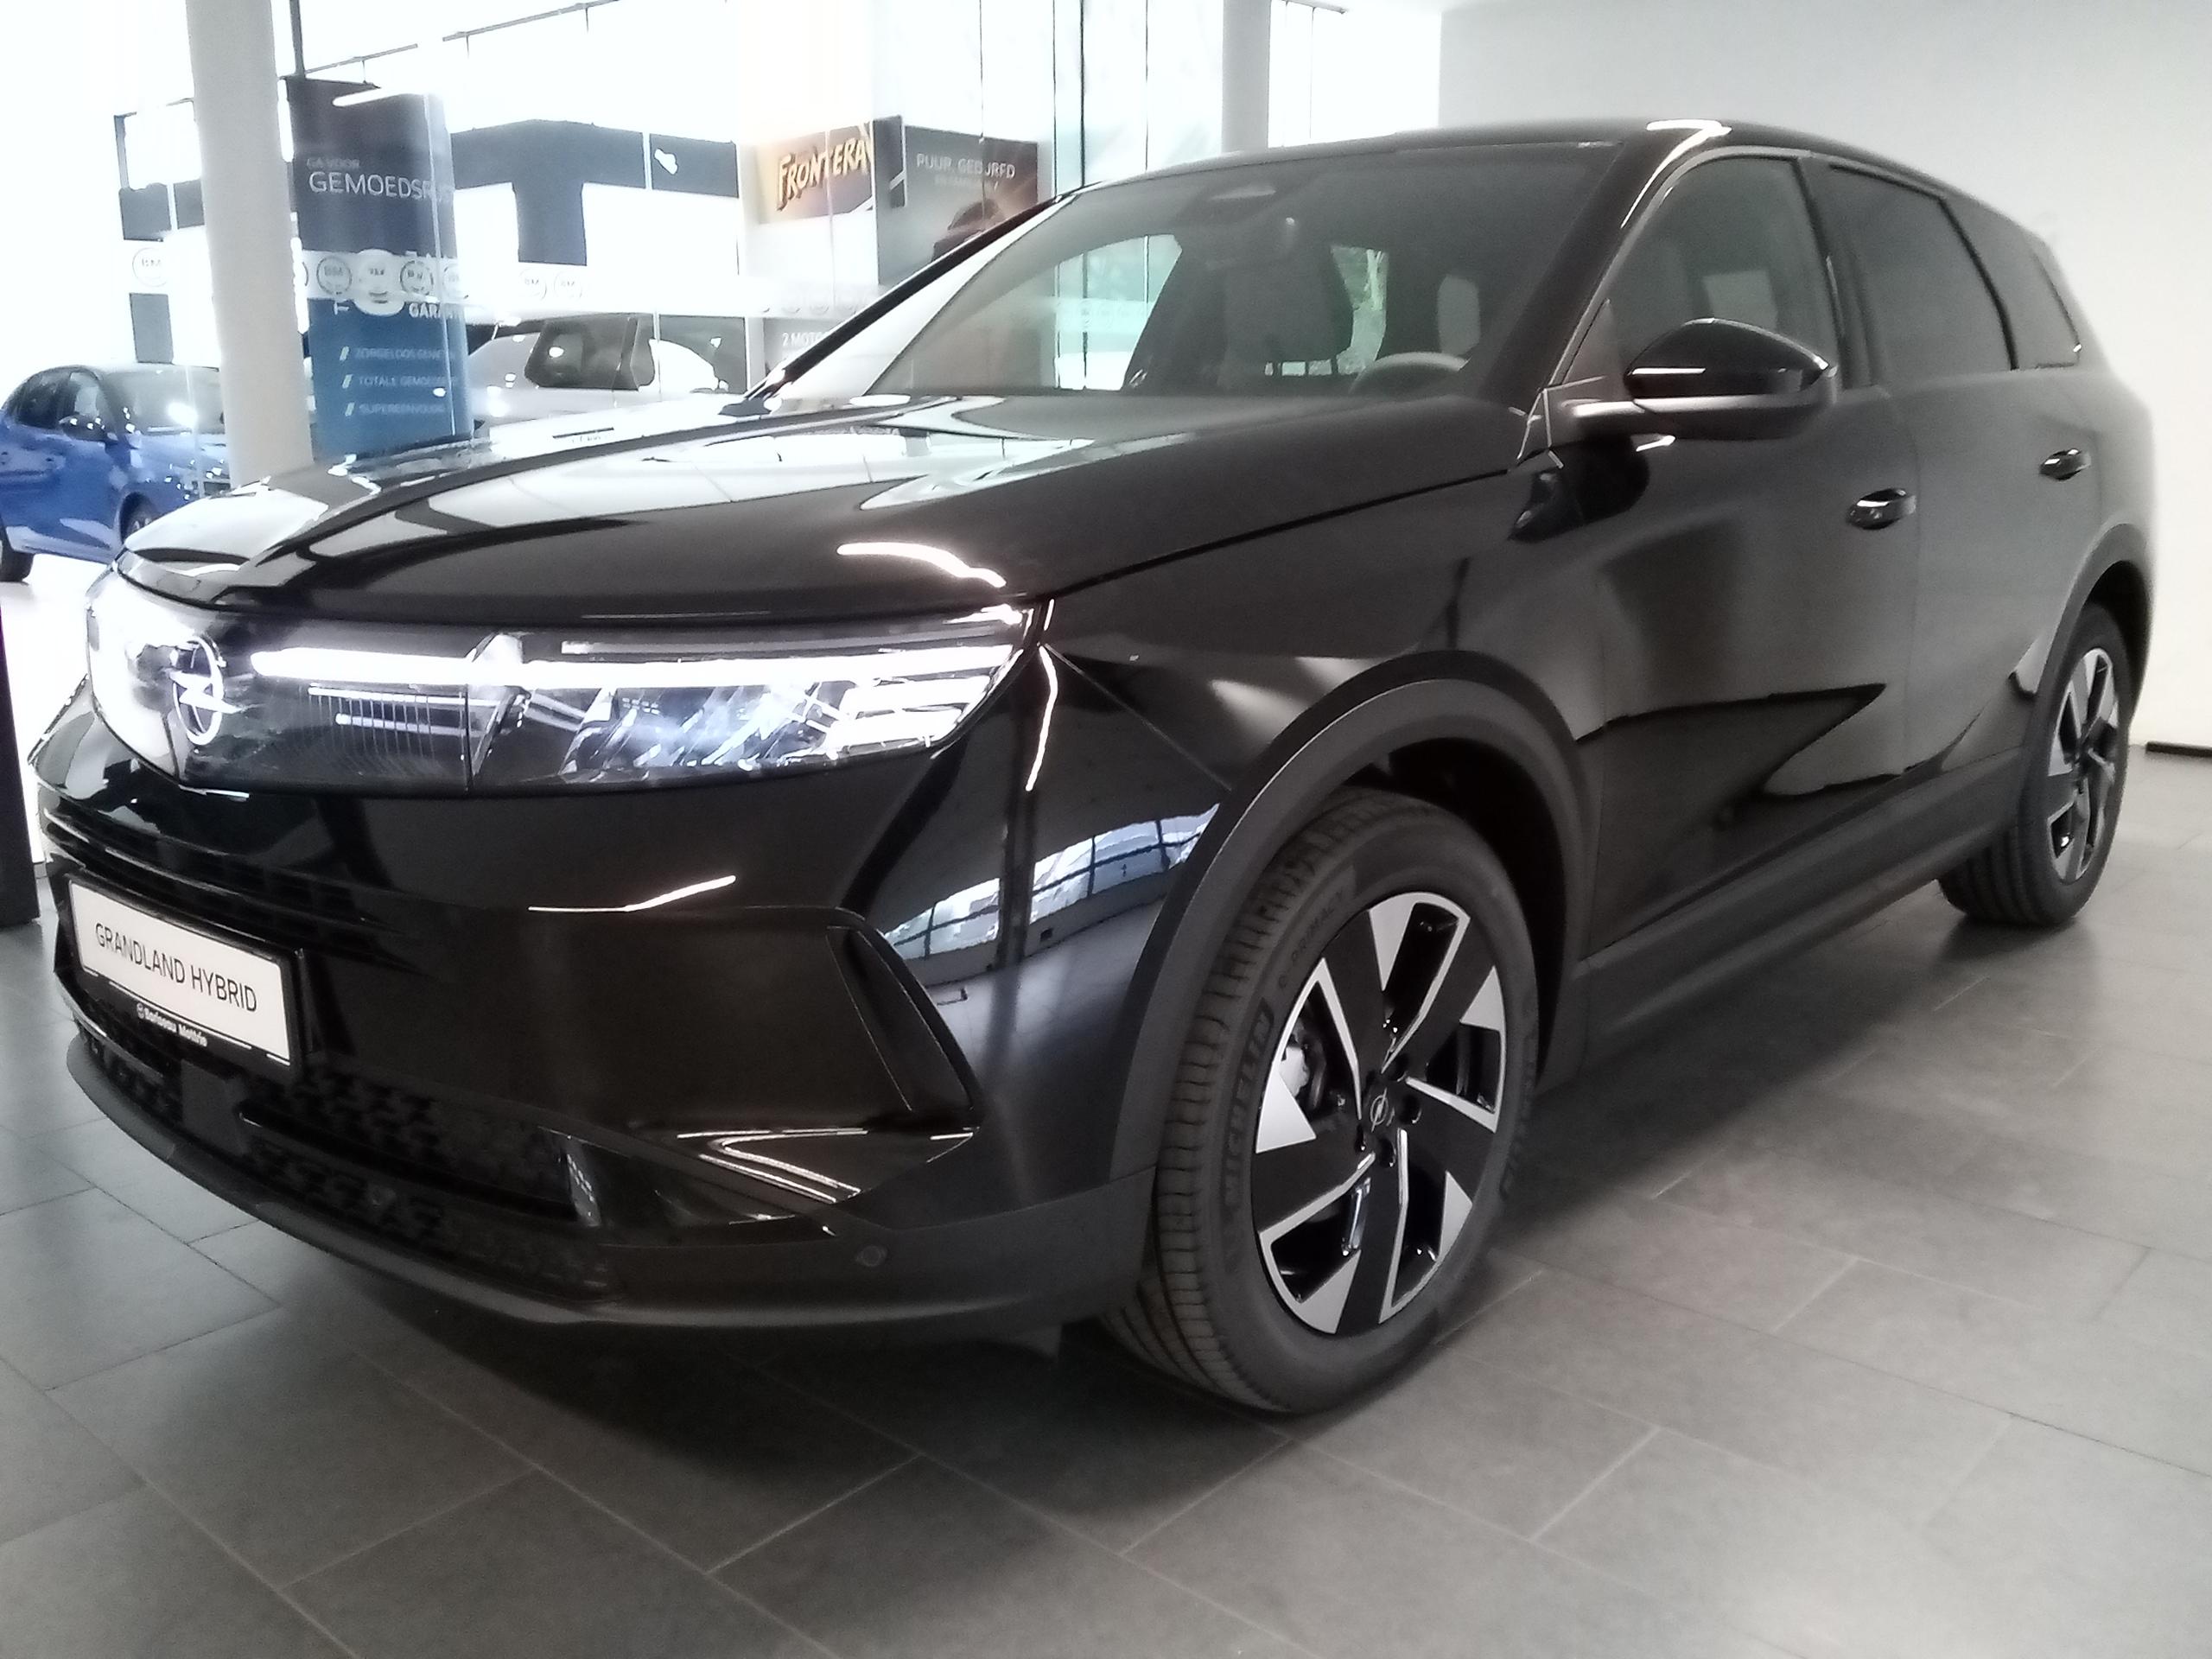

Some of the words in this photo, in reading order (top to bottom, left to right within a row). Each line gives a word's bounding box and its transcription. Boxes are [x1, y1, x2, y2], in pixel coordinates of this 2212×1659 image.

[777, 137, 868, 211] FRONTERA
[95, 922, 186, 984] GRANDLAND
[190, 964, 257, 1013] HYBRID
